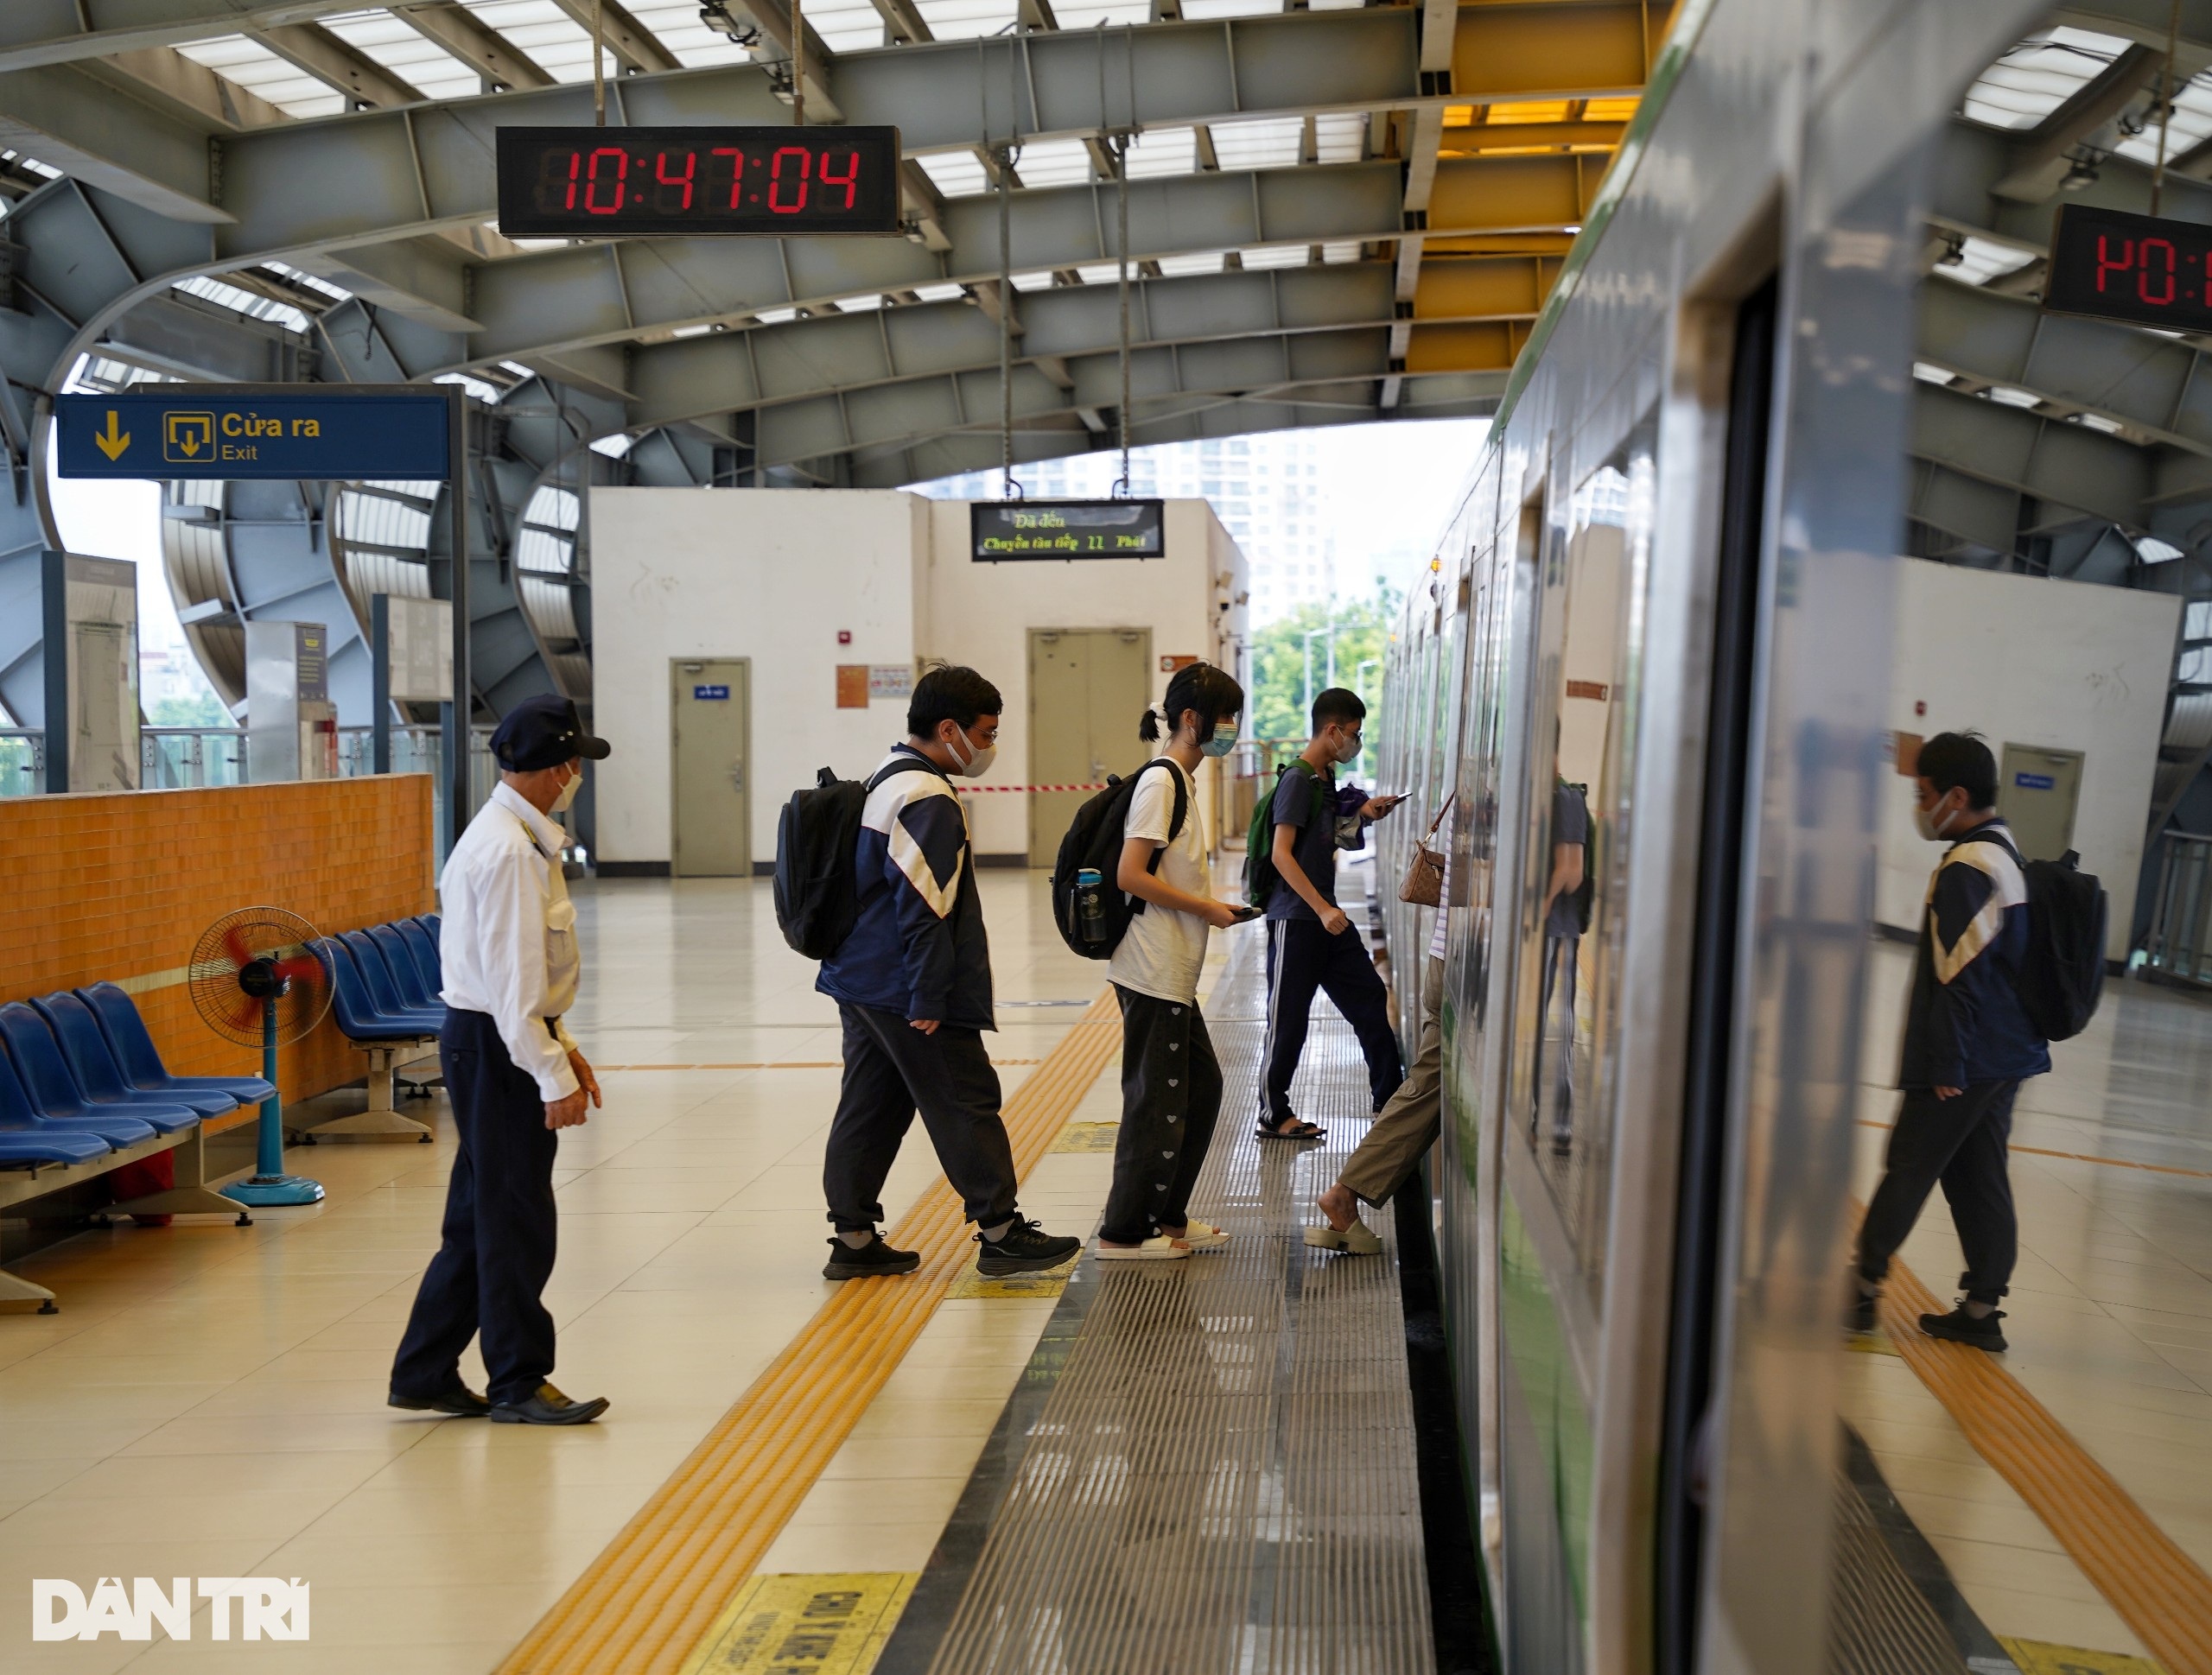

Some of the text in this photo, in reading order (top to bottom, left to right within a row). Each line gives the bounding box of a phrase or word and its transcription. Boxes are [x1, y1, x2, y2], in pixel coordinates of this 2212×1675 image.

[565, 146, 860, 215] 10:47:04
[221, 412, 321, 437] Cửa ra
[221, 444, 257, 460] Exit
[983, 533, 1029, 553] Chuyến
[1055, 532, 1079, 552] tiếp
